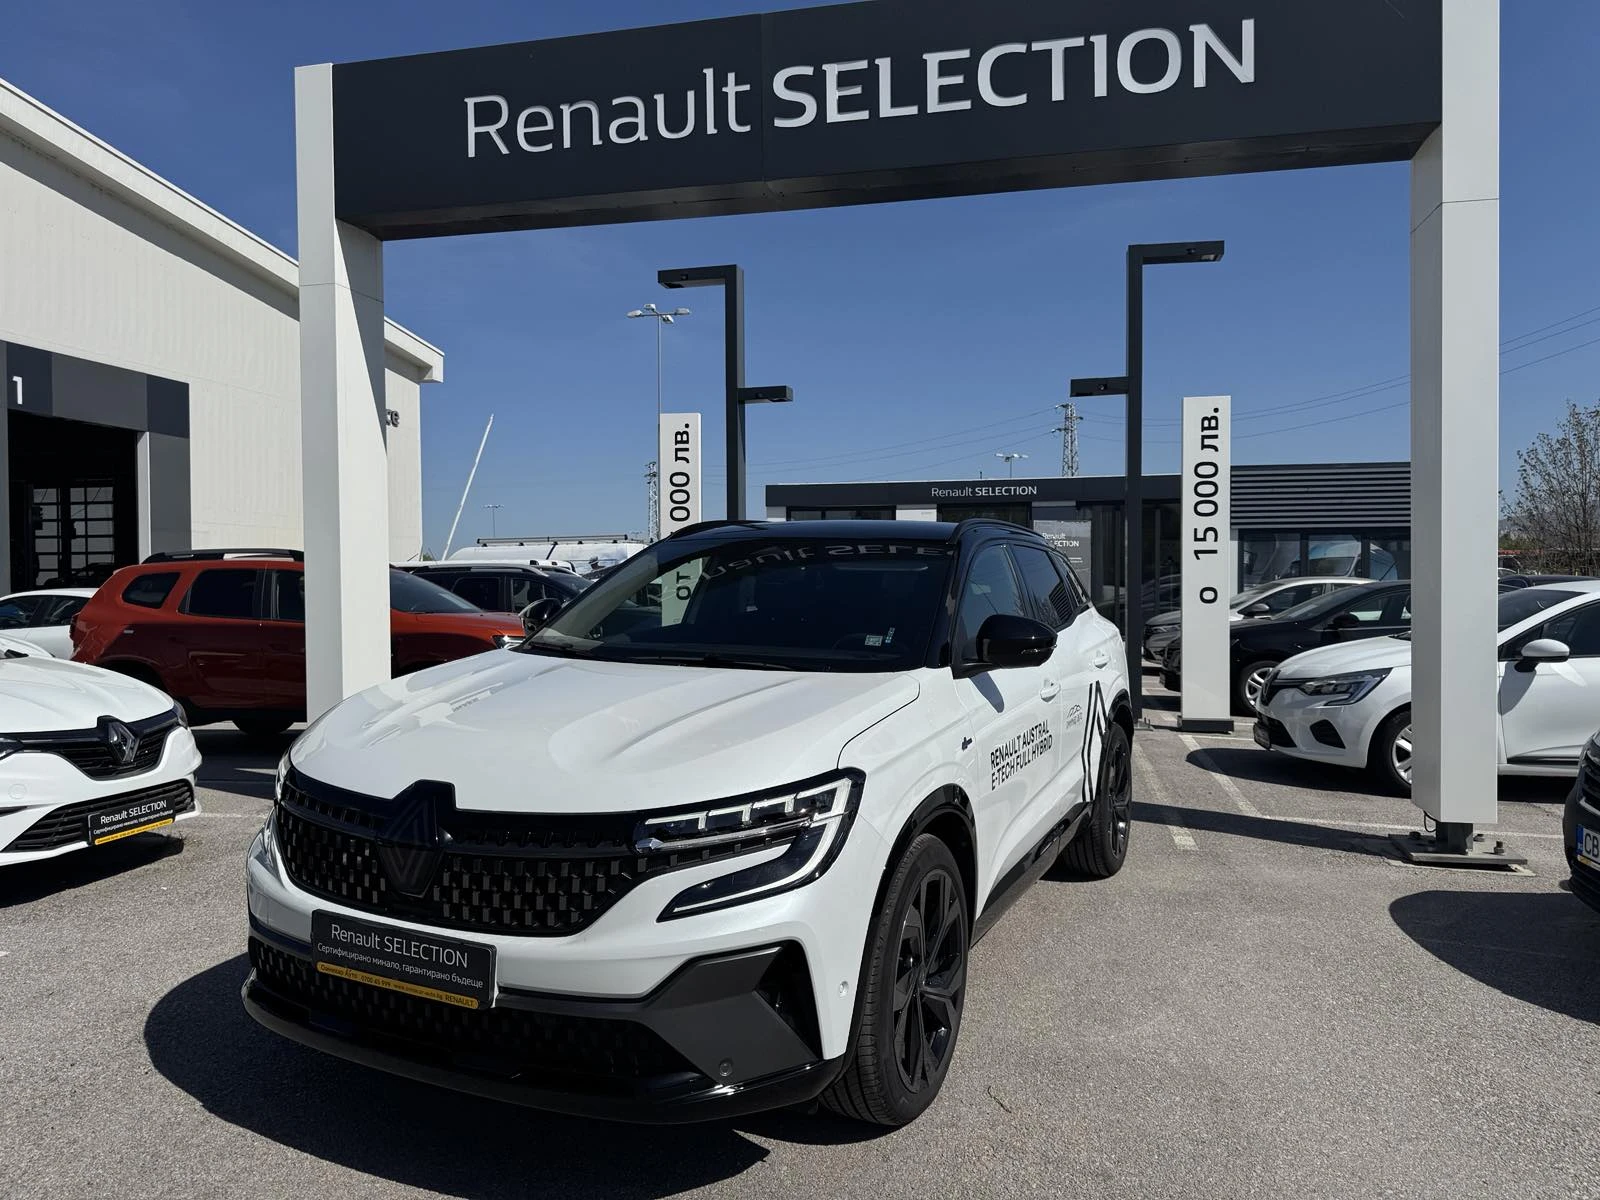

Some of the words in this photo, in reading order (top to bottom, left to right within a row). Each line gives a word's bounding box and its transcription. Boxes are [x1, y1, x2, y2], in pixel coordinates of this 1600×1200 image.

[463, 67, 751, 158] Renault
[771, 18, 1255, 129] SELECTION
[12, 375, 23, 405] 1
[675, 423, 690, 464] лв.
[1200, 407, 1219, 452] лв.
[669, 471, 690, 522] 000
[931, 486, 974, 497] Renault
[975, 485, 1037, 497] SELECTION
[1193, 461, 1219, 517] 000
[1193, 526, 1219, 560] 15
[990, 734, 1022, 770] RENAULT
[1022, 719, 1050, 751] AUSTRAL
[991, 758, 1016, 791] E-TECH
[1015, 745, 1032, 772] FULL
[1031, 734, 1053, 760] HYBRID
[100, 810, 128, 824] Renault
[129, 800, 167, 818] SELECTION
[317, 942, 372, 964] Сертифицирано
[371, 956, 402, 971] минало,
[402, 963, 450, 983] гарантирано
[451, 973, 484, 989] бъдеще
[331, 923, 381, 950] Renault
[384, 936, 468, 968] SELECTION
[444, 994, 475, 1007] RENAULT
